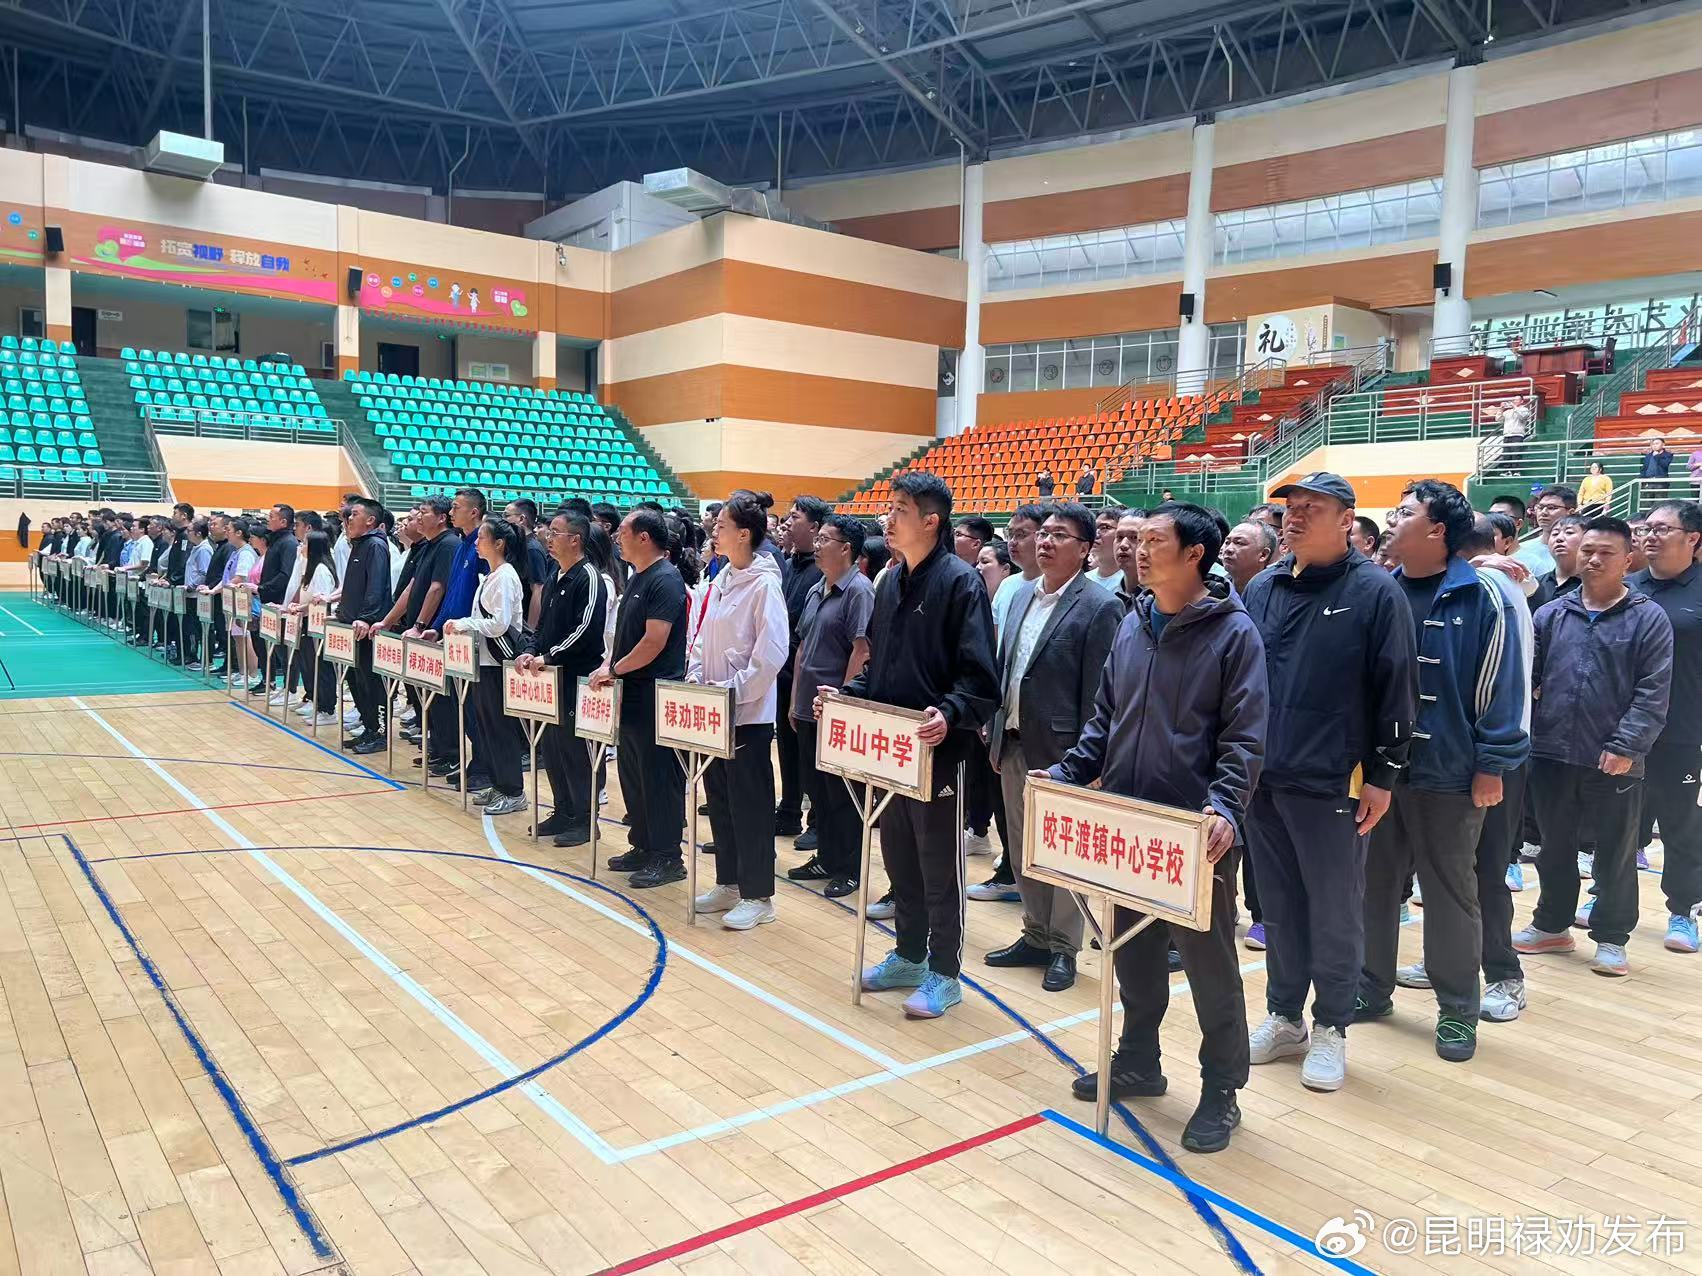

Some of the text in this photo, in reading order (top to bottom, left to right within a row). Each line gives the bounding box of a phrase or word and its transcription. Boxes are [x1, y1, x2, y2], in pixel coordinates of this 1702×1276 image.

[160, 239, 224, 261] 拓宽视野
[229, 249, 290, 272] 释放自我
[1258, 323, 1285, 354] 礼
[408, 651, 444, 677] 禄劝消防
[448, 643, 470, 665] 统计队
[509, 678, 553, 705] 屏山中心幼儿园
[581, 695, 612, 723] 禄劝民族中学
[664, 700, 722, 735] 禄劝职中
[828, 718, 913, 768] 屏山中学
[1042, 810, 1184, 887] 皎平渡镇中心学校
